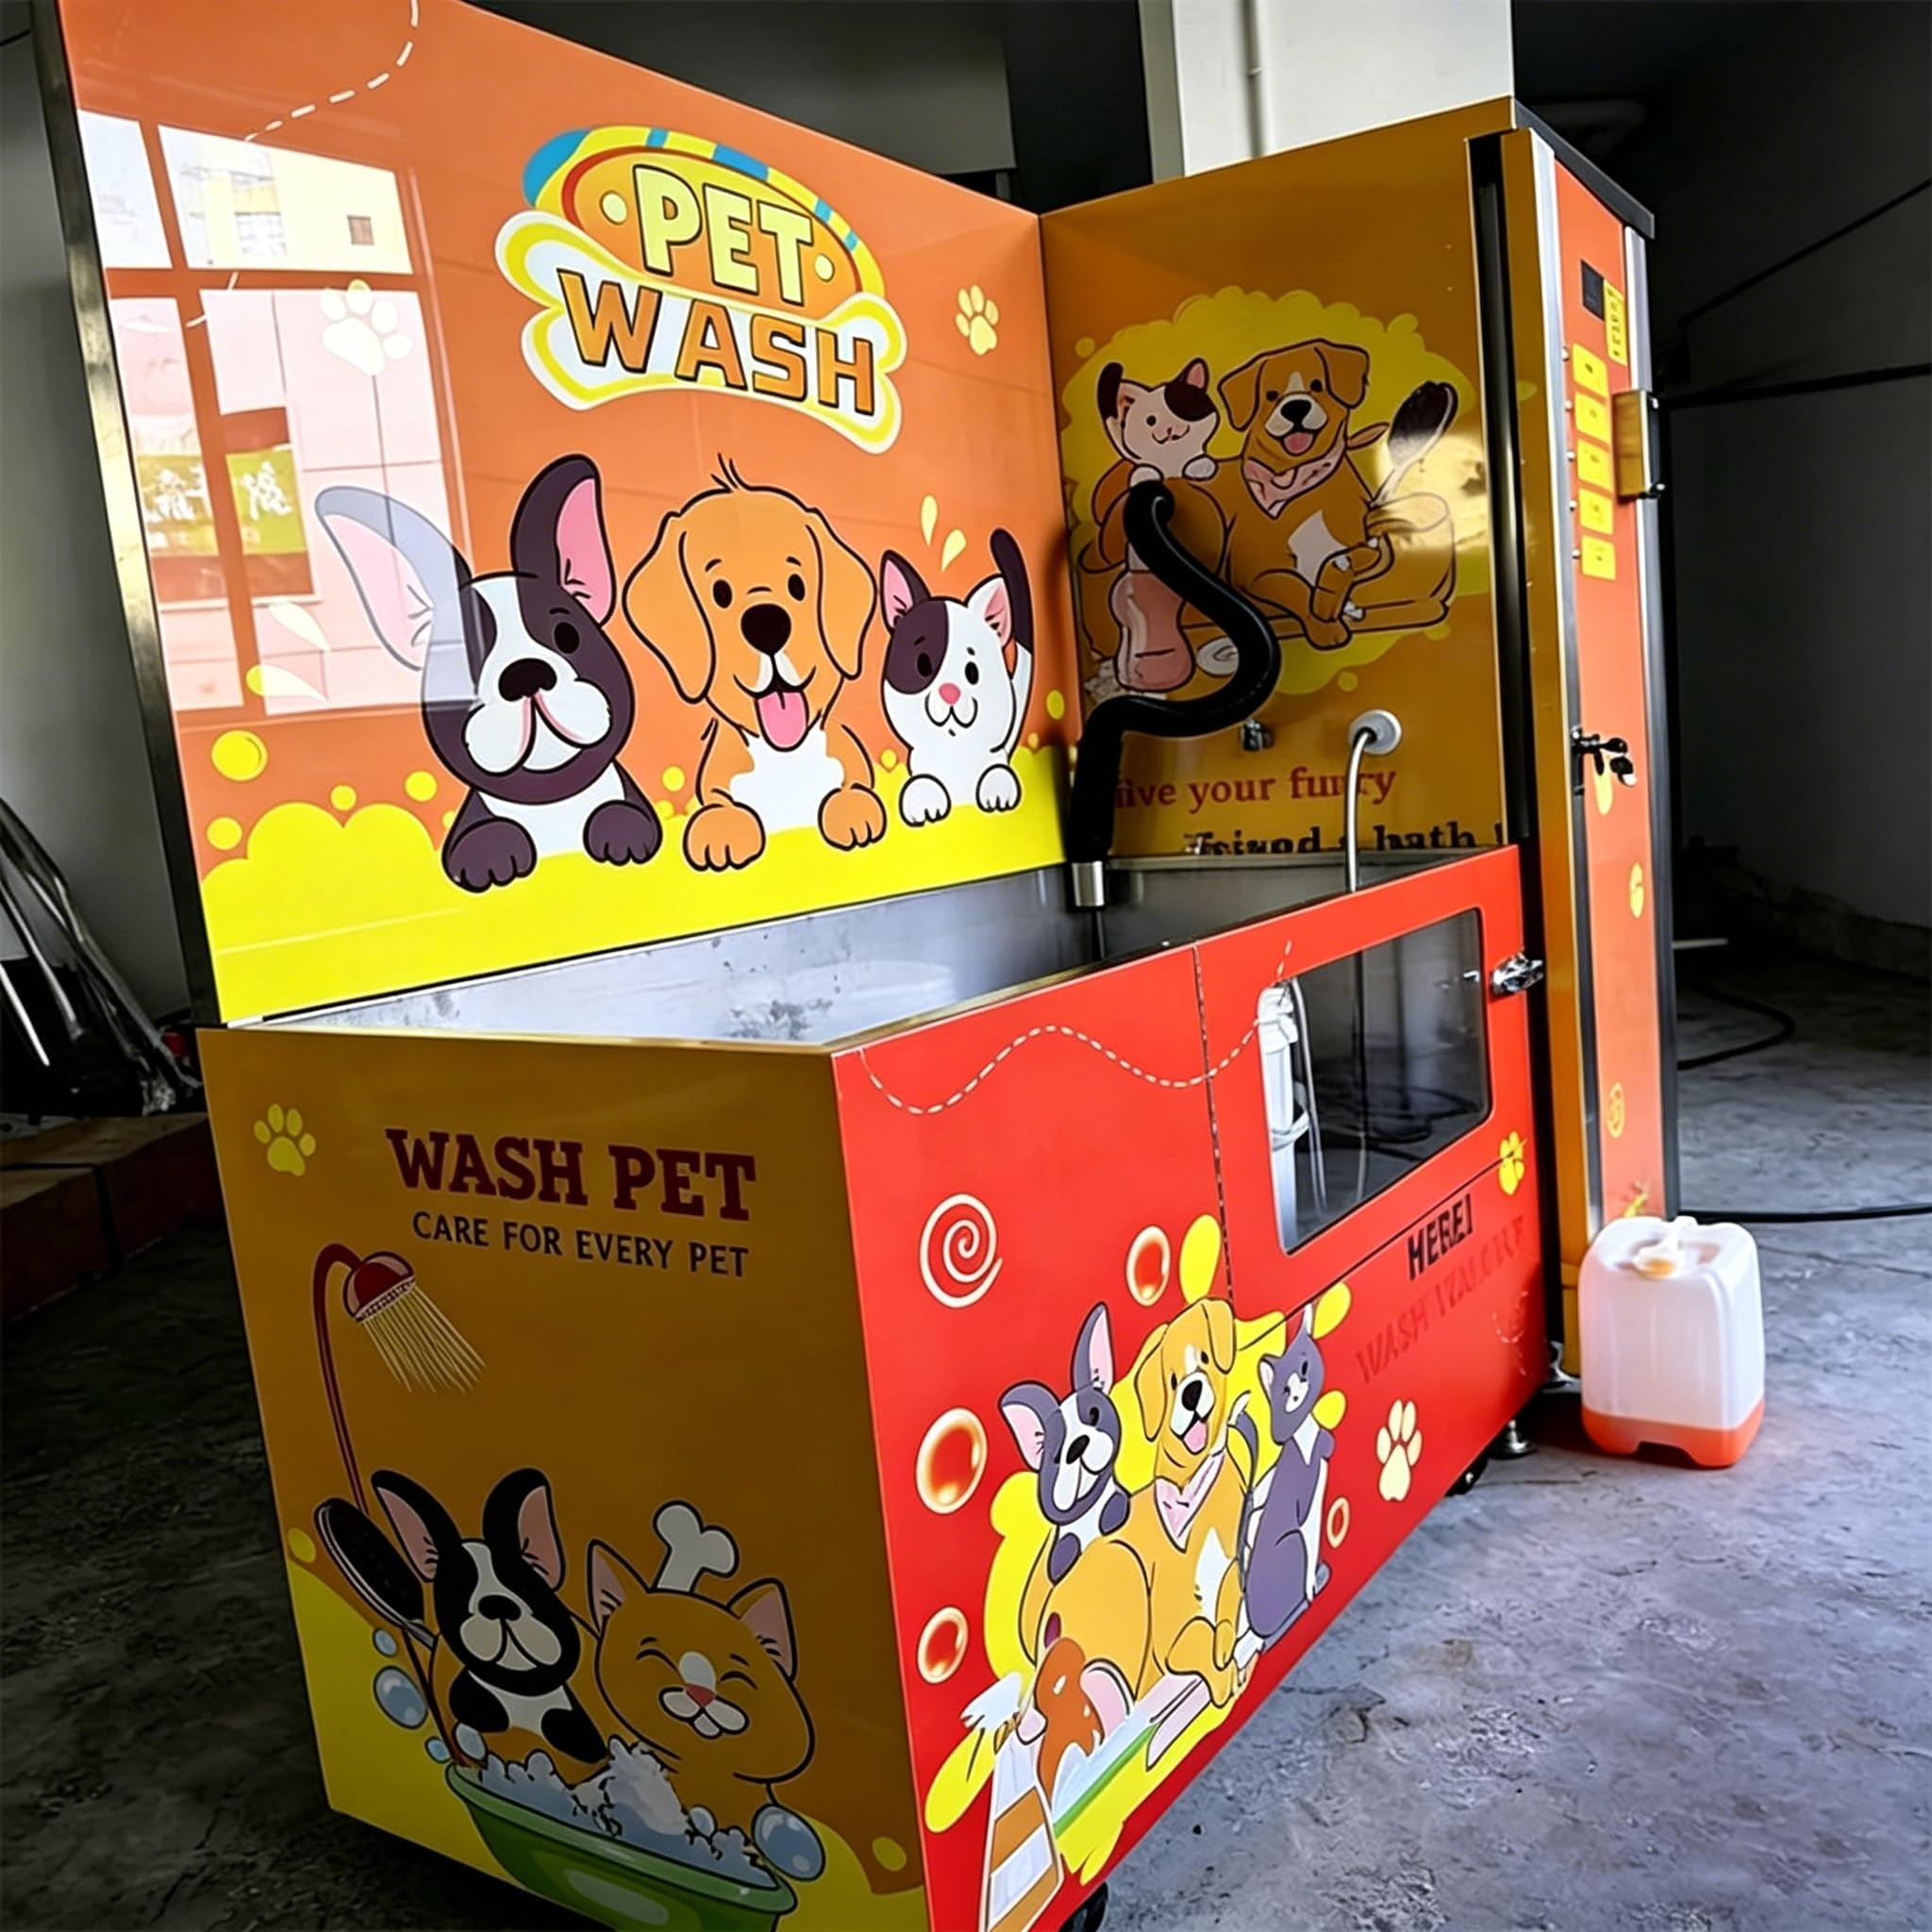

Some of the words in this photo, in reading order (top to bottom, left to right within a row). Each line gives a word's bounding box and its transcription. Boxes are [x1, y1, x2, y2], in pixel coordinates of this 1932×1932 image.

[633, 164, 814, 307] PET
[557, 268, 874, 416] WASH
[1187, 777, 1276, 815] your
[385, 1127, 589, 1206] WASH
[608, 1144, 757, 1222] PET
[412, 1210, 489, 1246] CARE
[503, 1221, 563, 1256] FOR
[575, 1229, 674, 1270] EVERY
[689, 1241, 749, 1277] PET
